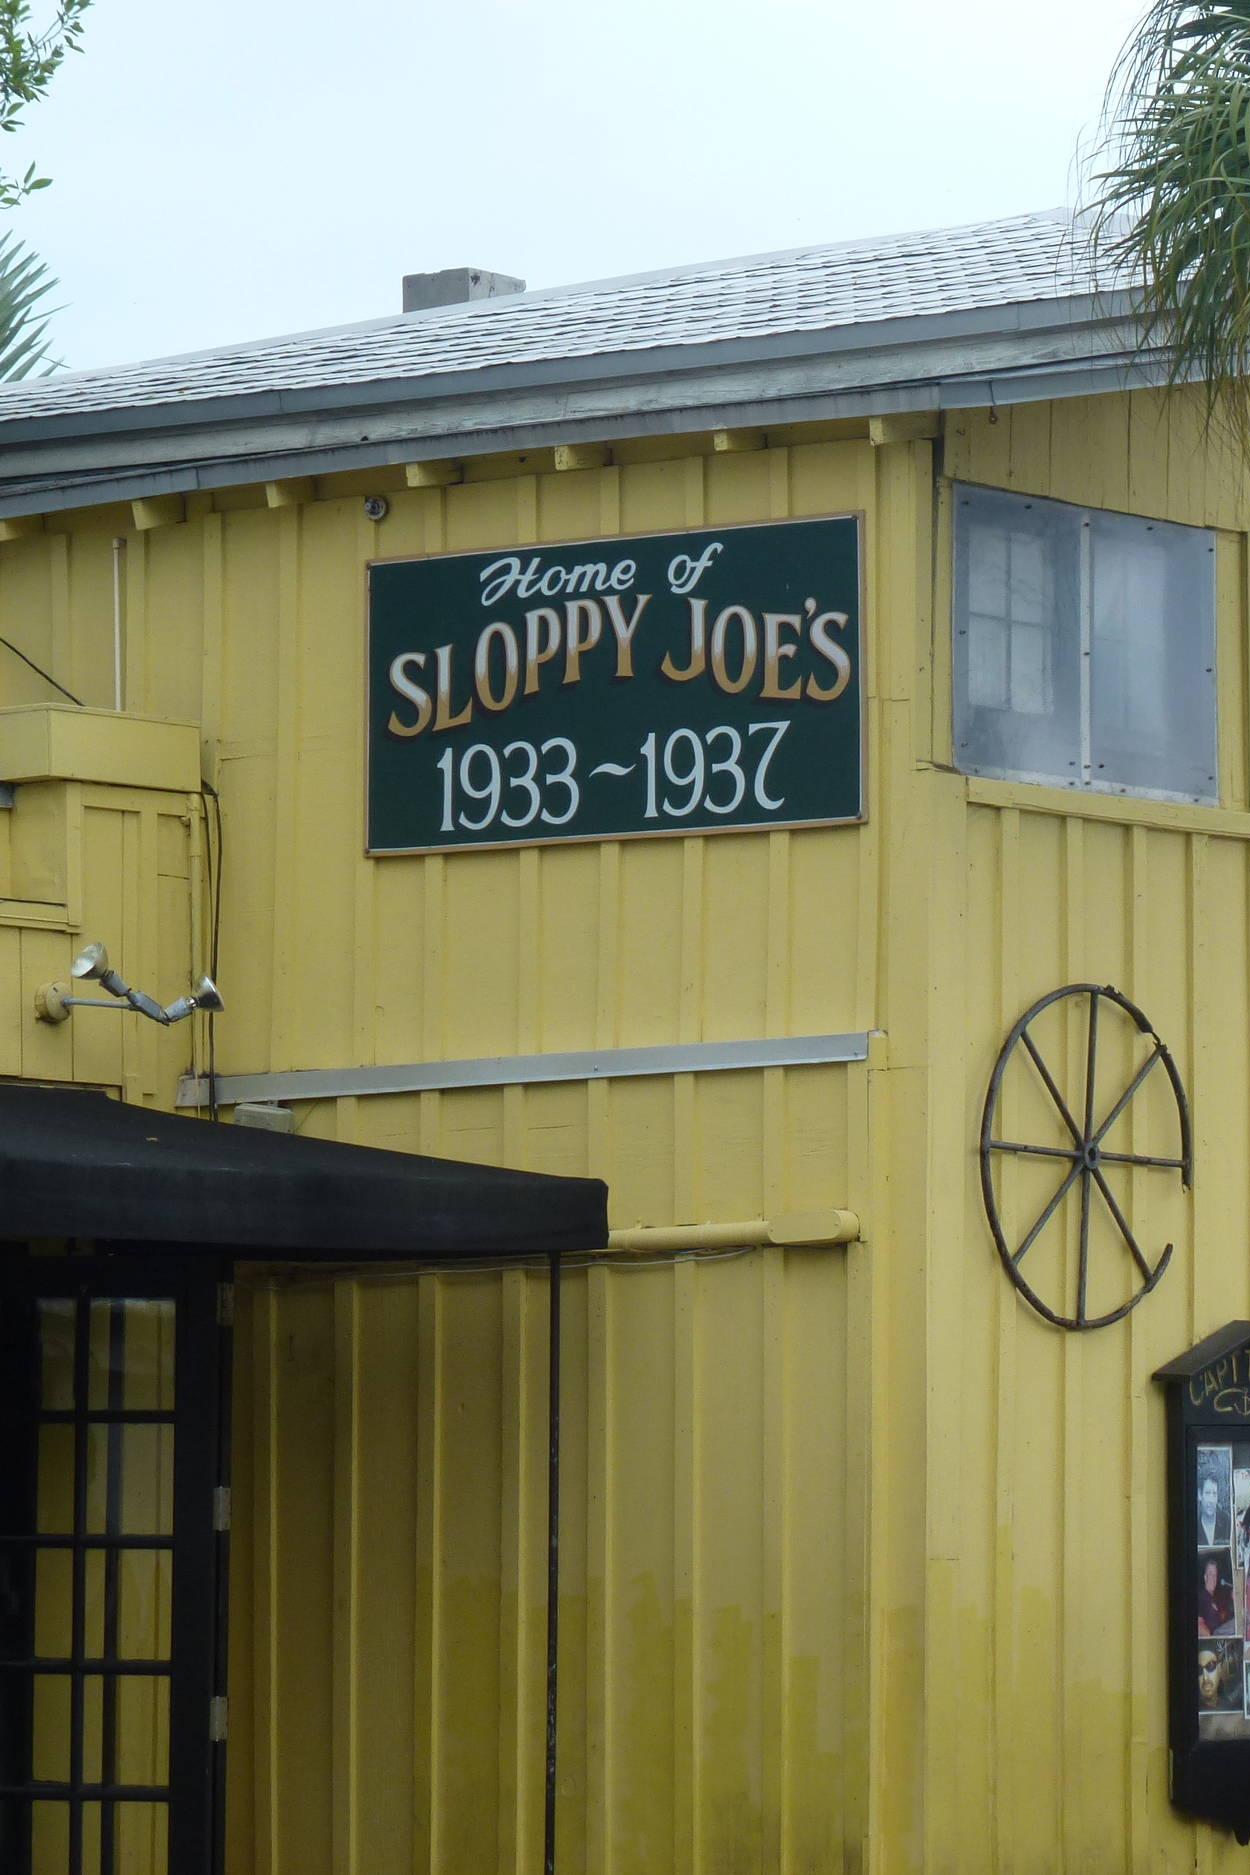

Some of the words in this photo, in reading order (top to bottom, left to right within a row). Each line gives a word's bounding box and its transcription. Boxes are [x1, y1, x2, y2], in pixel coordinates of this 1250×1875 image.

[479, 556, 637, 606] Home
[667, 542, 724, 594] of
[387, 593, 653, 738] SLOPPY
[660, 597, 852, 703] JOE'S
